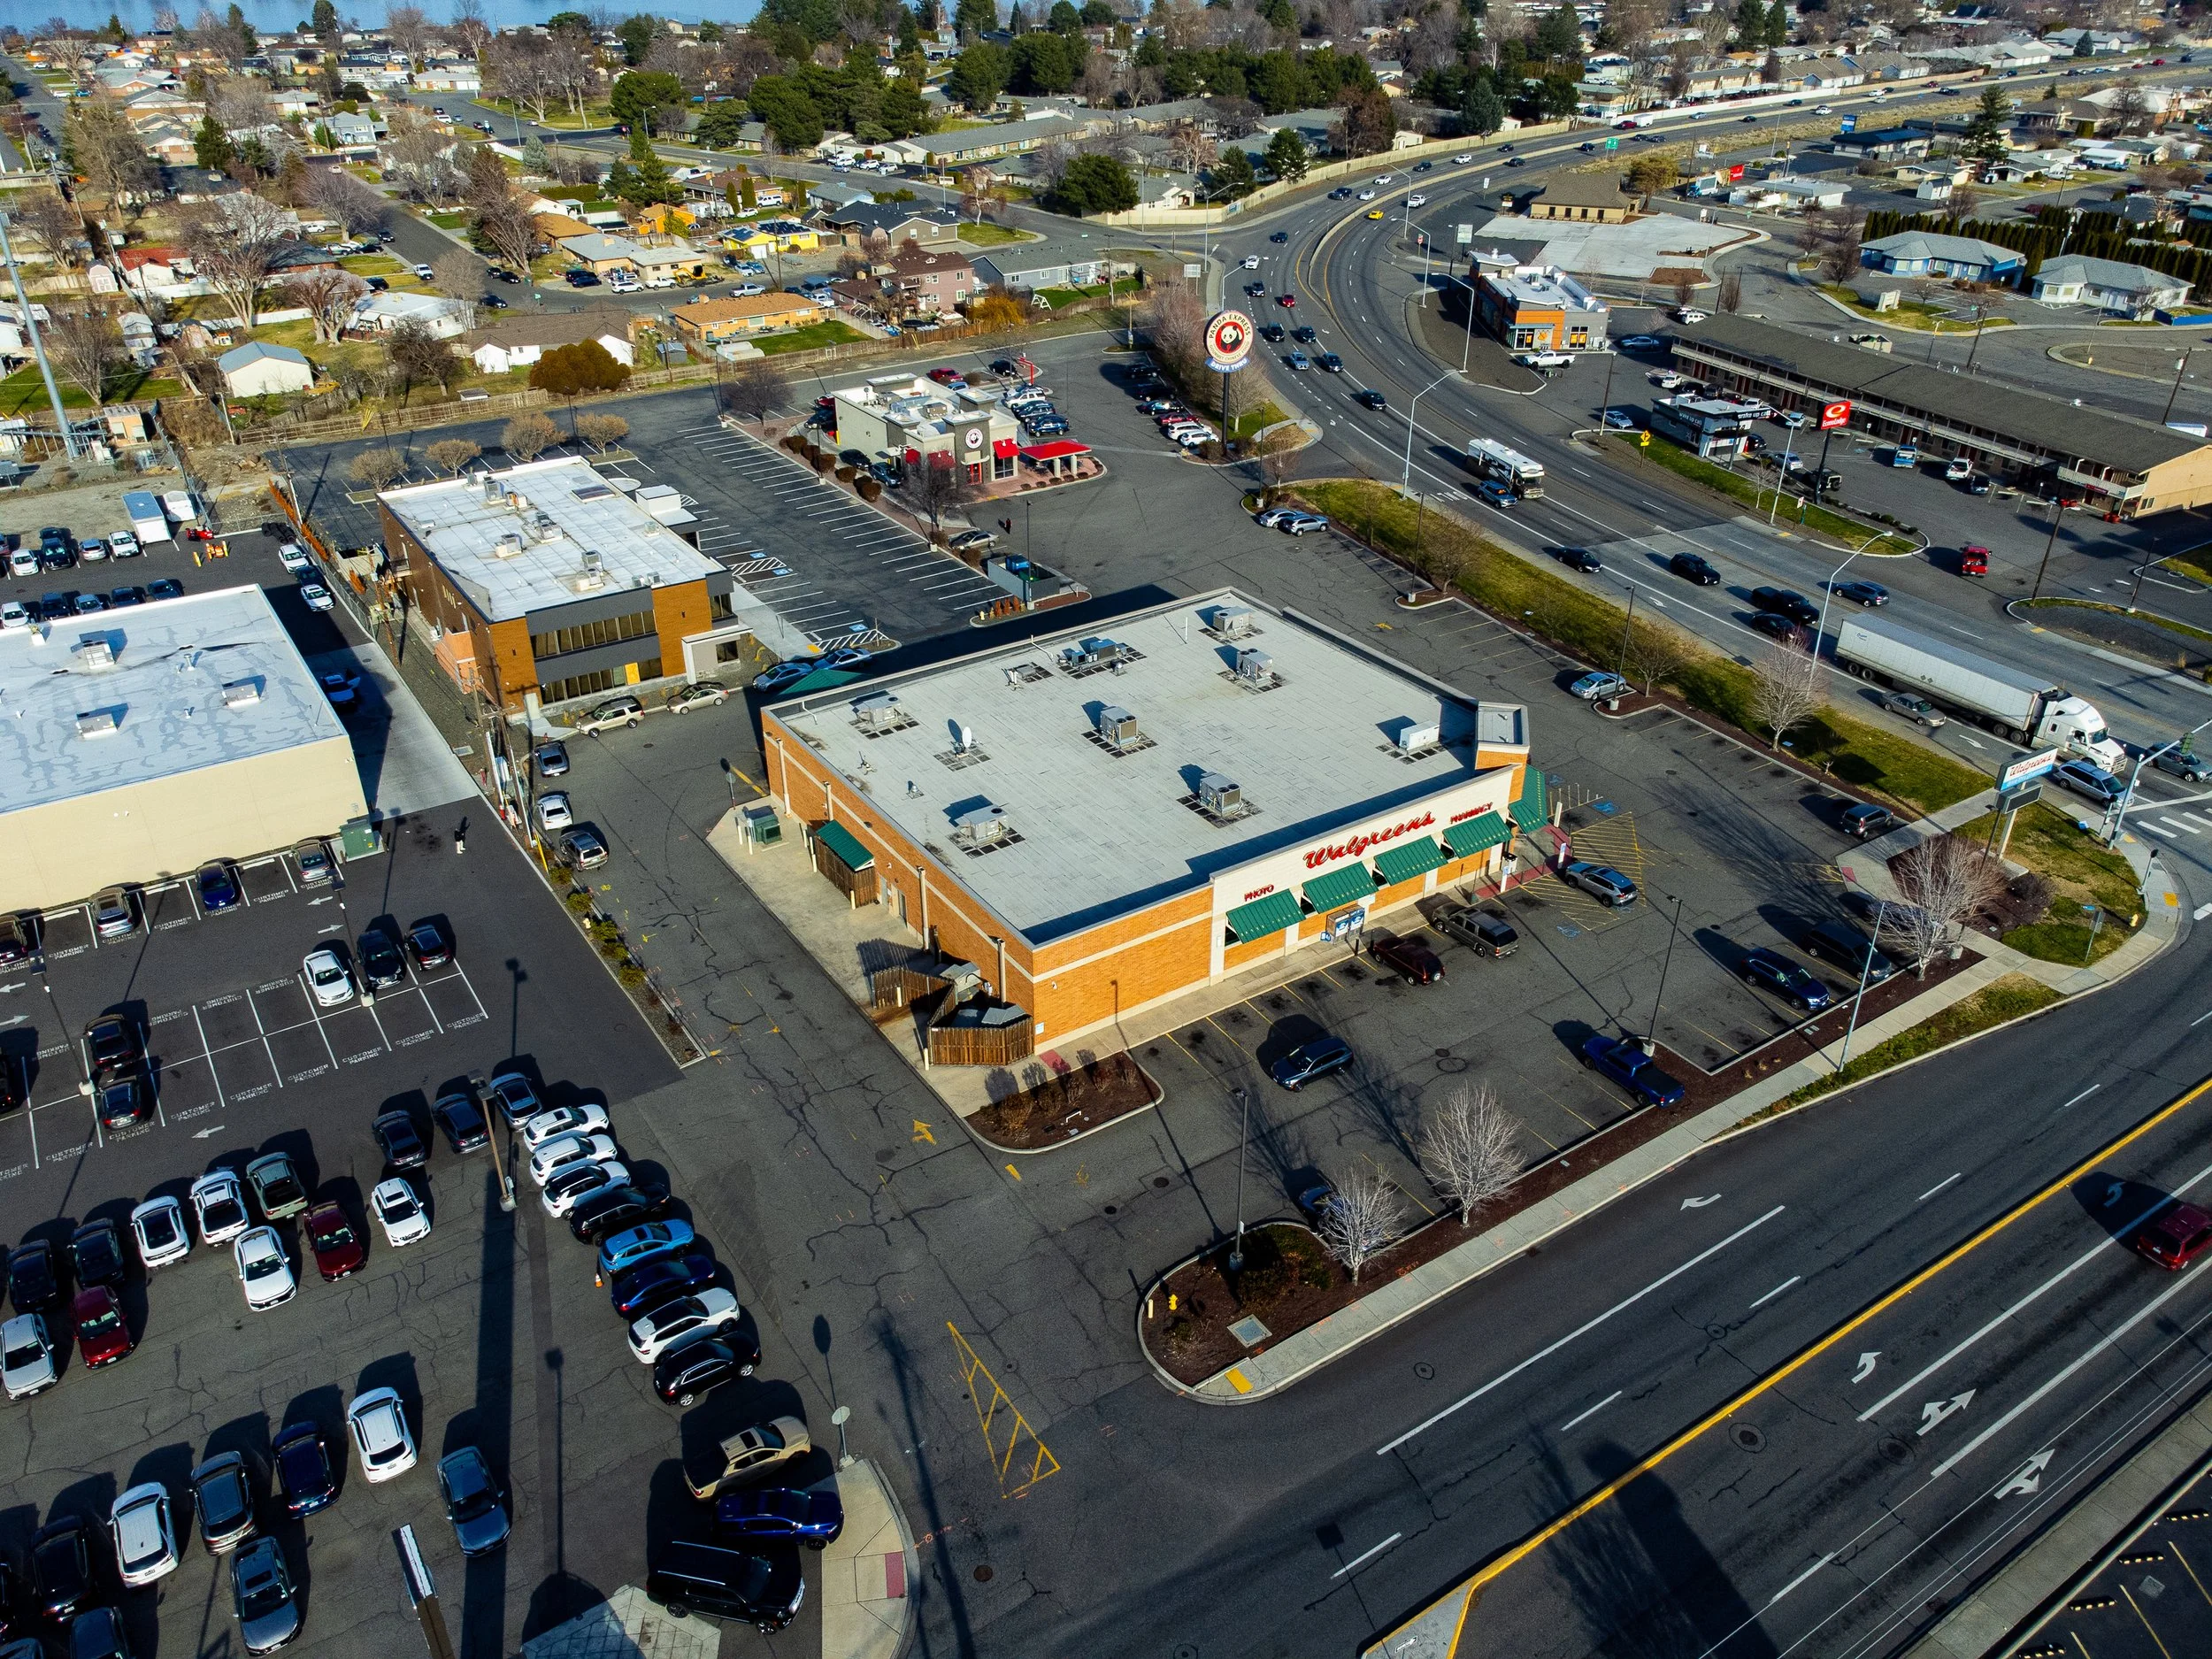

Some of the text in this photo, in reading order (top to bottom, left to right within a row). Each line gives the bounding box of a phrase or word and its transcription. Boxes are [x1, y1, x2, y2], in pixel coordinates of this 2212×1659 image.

[1209, 313, 1251, 339] PANDA EXPRESS
[1210, 357, 1248, 371] DRIVE THRU
[2009, 754, 2052, 777] Walgreens
[1450, 802, 1493, 824] PHARMACY
[1303, 811, 1436, 869] Walgreens
[301, 877, 333, 888] CUSTOME
[253, 889, 289, 902] CUSTOMER
[258, 893, 286, 903] PARKING
[1244, 884, 1274, 902] PHOTO
[154, 916, 192, 930] CUSTOMER
[49, 944, 88, 958] CUSTOMER
[54, 949, 84, 960] PARKING
[446, 1012, 486, 1028] CUSTOMER
[454, 1018, 482, 1030] PARKING
[396, 1029, 434, 1045] CUSTOMER
[402, 1034, 432, 1048] PARKING
[342, 1047, 383, 1064] CUSTOMER
[349, 1052, 380, 1065] PARKING
[288, 1064, 329, 1081] CUSTOMER
[294, 1070, 326, 1083] PARKING
[229, 1082, 273, 1101] CUSTOMER
[237, 1089, 269, 1102] PARKING
[171, 1102, 216, 1120] CUSTOMER
[178, 1108, 211, 1122] PARKING
[46, 1141, 94, 1161] CUSTOMER
[0, 1163, 28, 1176] TOMER
